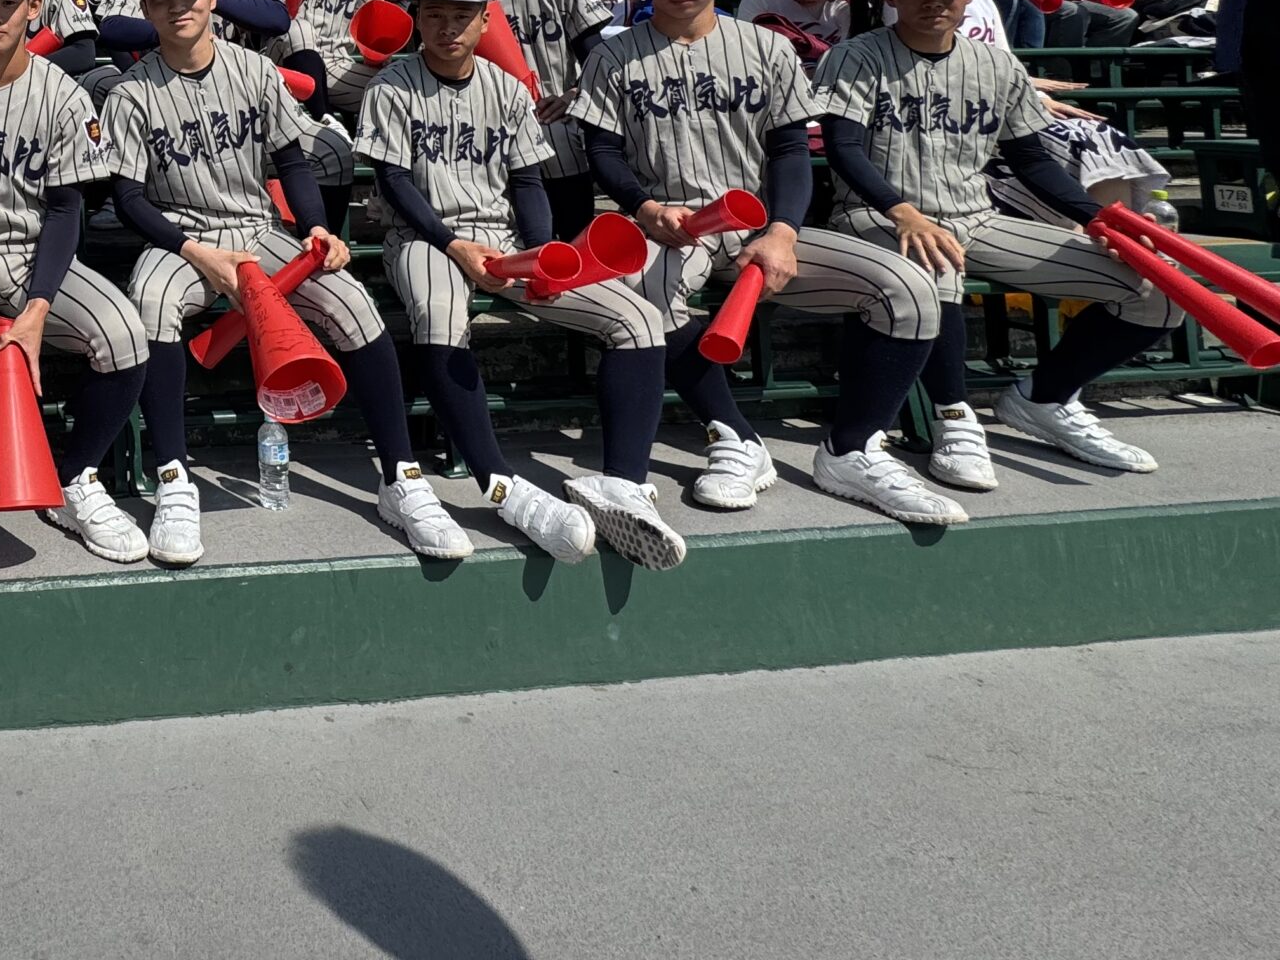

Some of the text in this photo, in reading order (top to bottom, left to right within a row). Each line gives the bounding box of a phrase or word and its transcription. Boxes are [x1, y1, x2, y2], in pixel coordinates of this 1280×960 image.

[625, 72, 767, 123] 敦賀気比
[873, 93, 1000, 136] 敦賀気比
[147, 106, 266, 173] 敦賀気比
[1218, 188, 1249, 202] 17段
